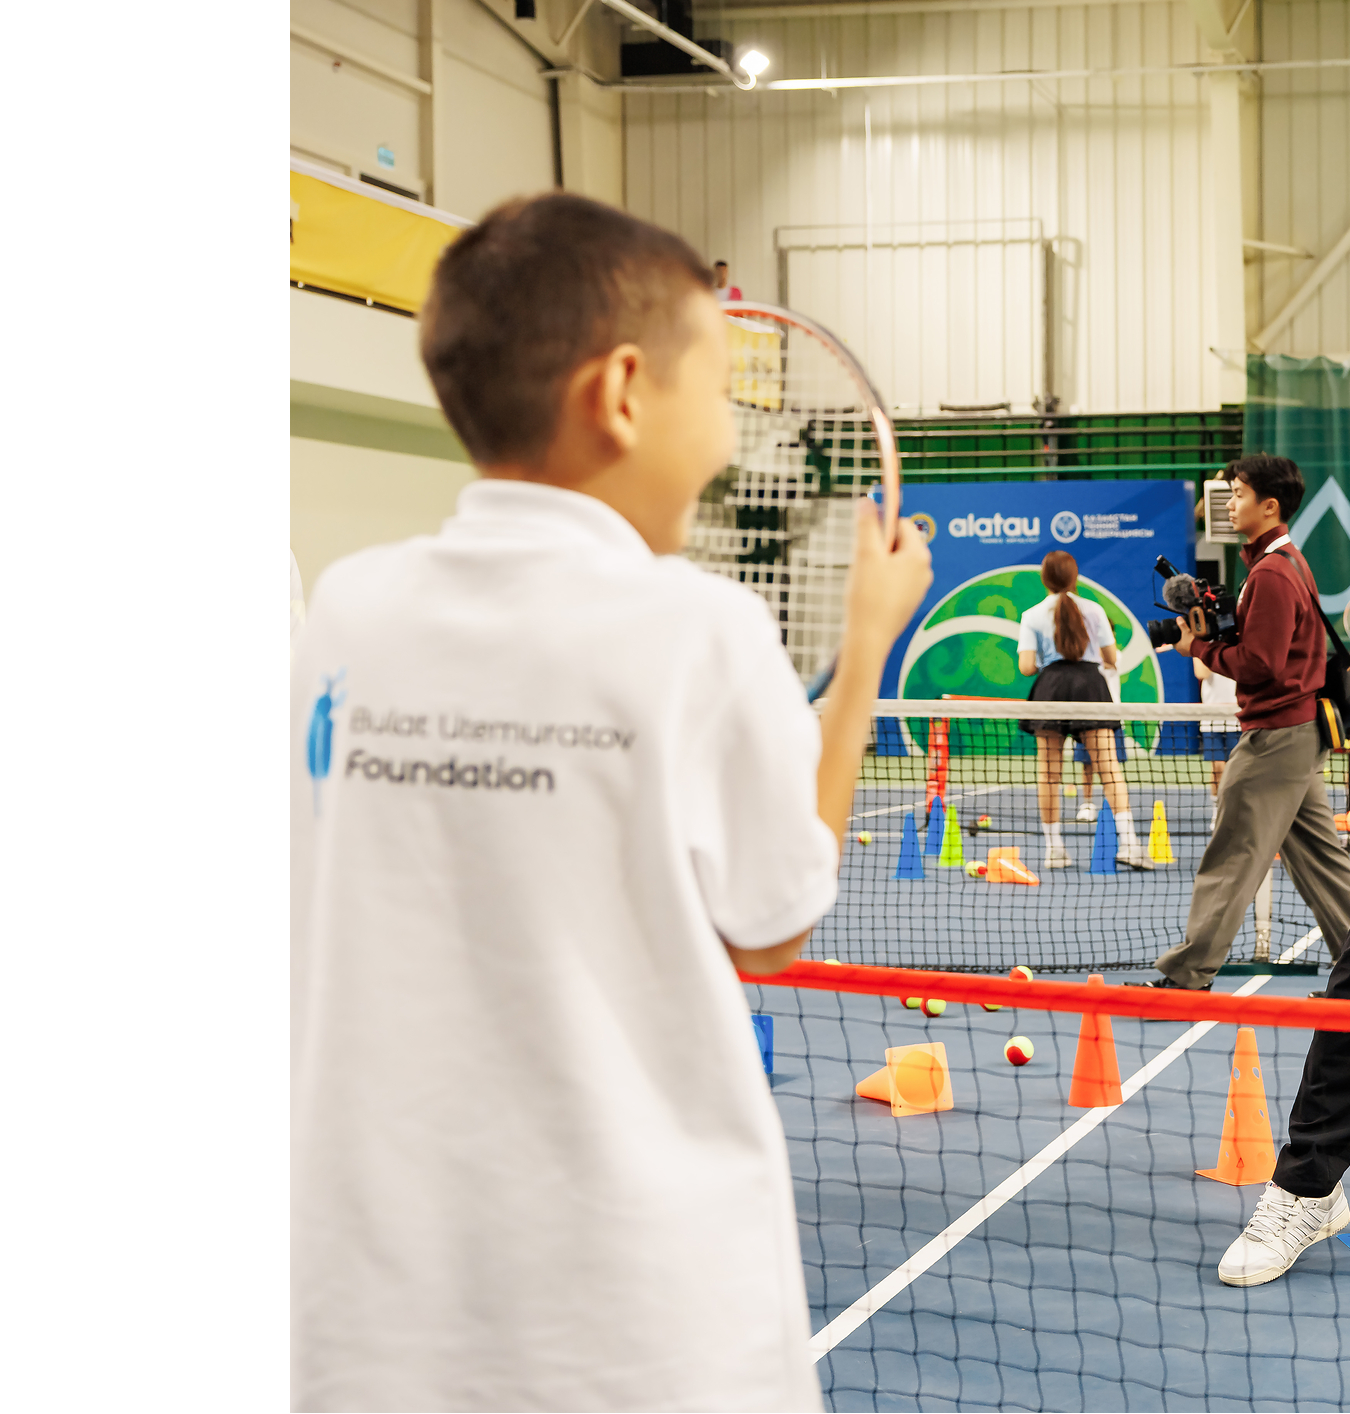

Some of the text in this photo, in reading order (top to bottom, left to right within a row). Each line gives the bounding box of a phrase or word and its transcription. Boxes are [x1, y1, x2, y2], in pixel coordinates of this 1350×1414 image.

[948, 513, 1041, 538] alatau
[350, 706, 637, 751] Bulat Utemuratov
[345, 748, 556, 793] Foundation
